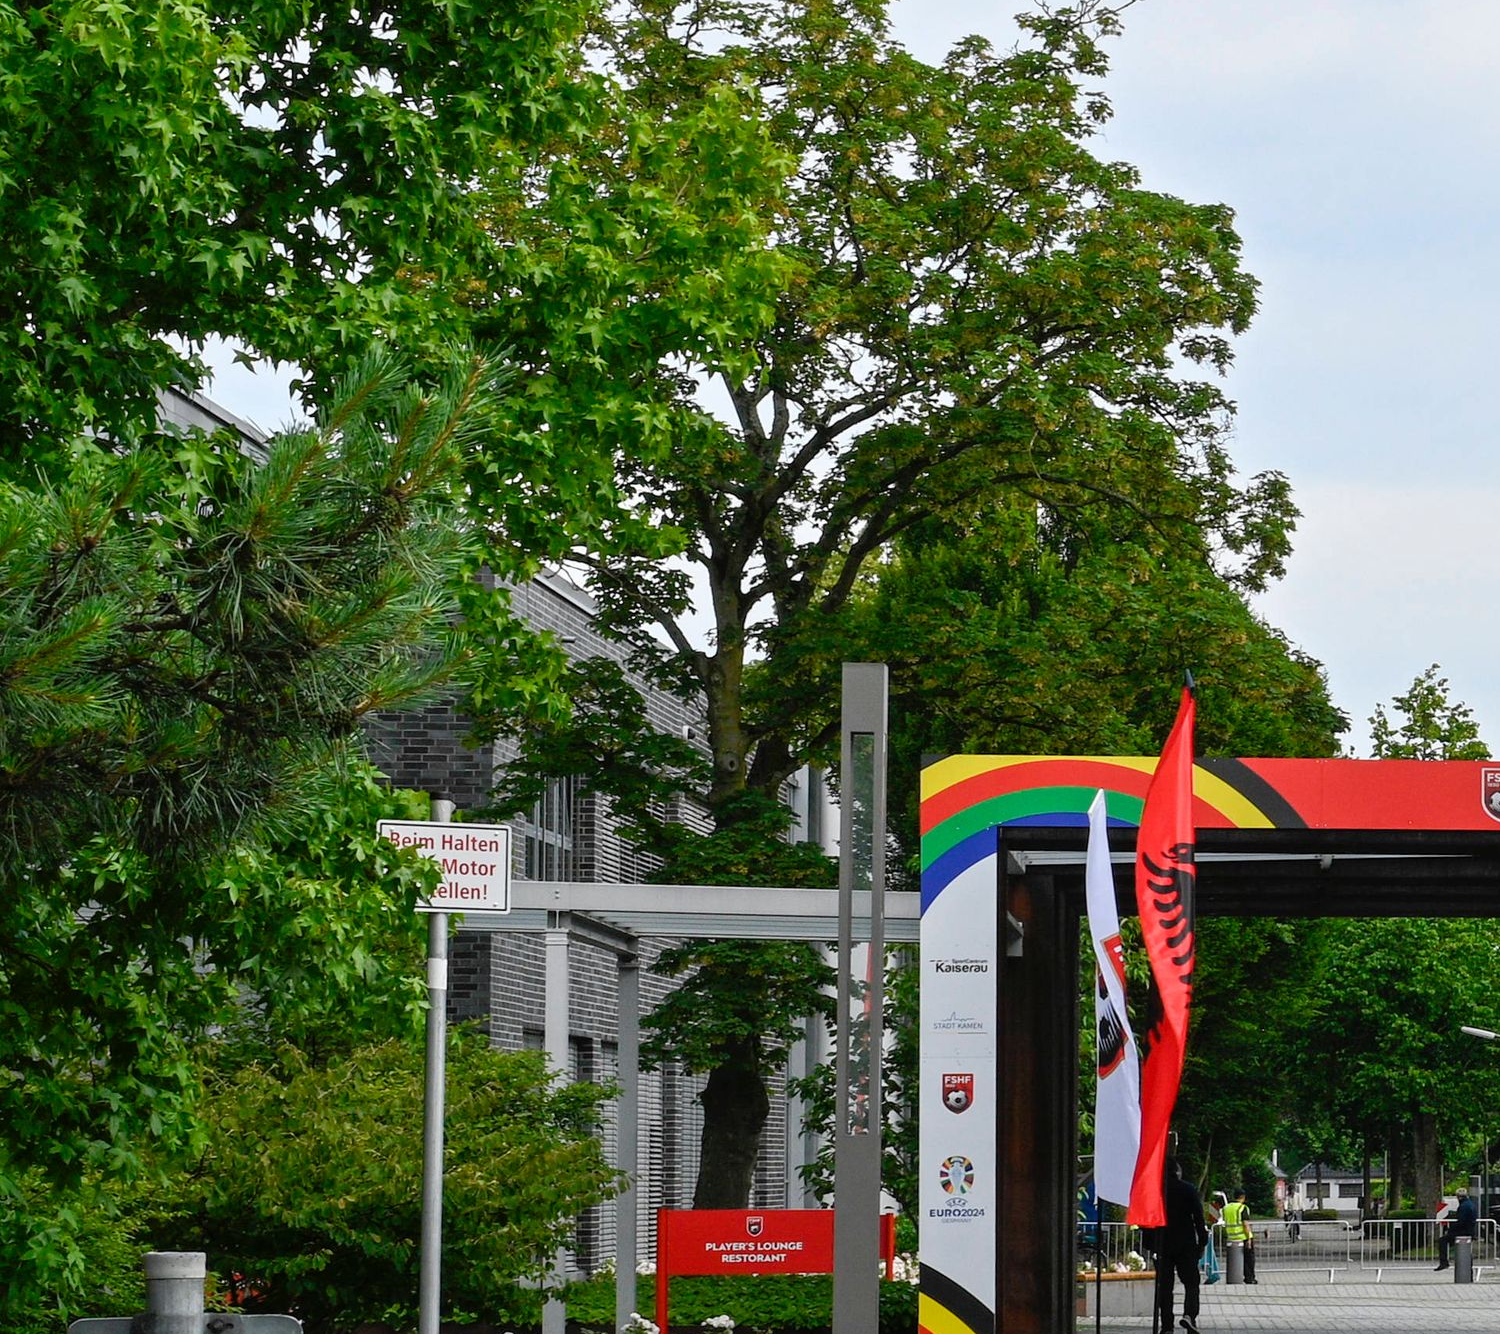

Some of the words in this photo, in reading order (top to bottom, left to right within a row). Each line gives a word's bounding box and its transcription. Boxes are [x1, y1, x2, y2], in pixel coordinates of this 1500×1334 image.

[390, 831, 434, 850] Beim
[441, 834, 499, 853] Halten
[441, 858, 497, 876] Motor
[935, 962, 989, 973] Kaiserau
[944, 1076, 972, 1084] FSHF
[929, 1208, 985, 1218] EURO2024
[705, 1242, 755, 1251] PLAYER'S
[757, 1242, 803, 1251] LOUNGE
[721, 1254, 787, 1263] RESTORANT
